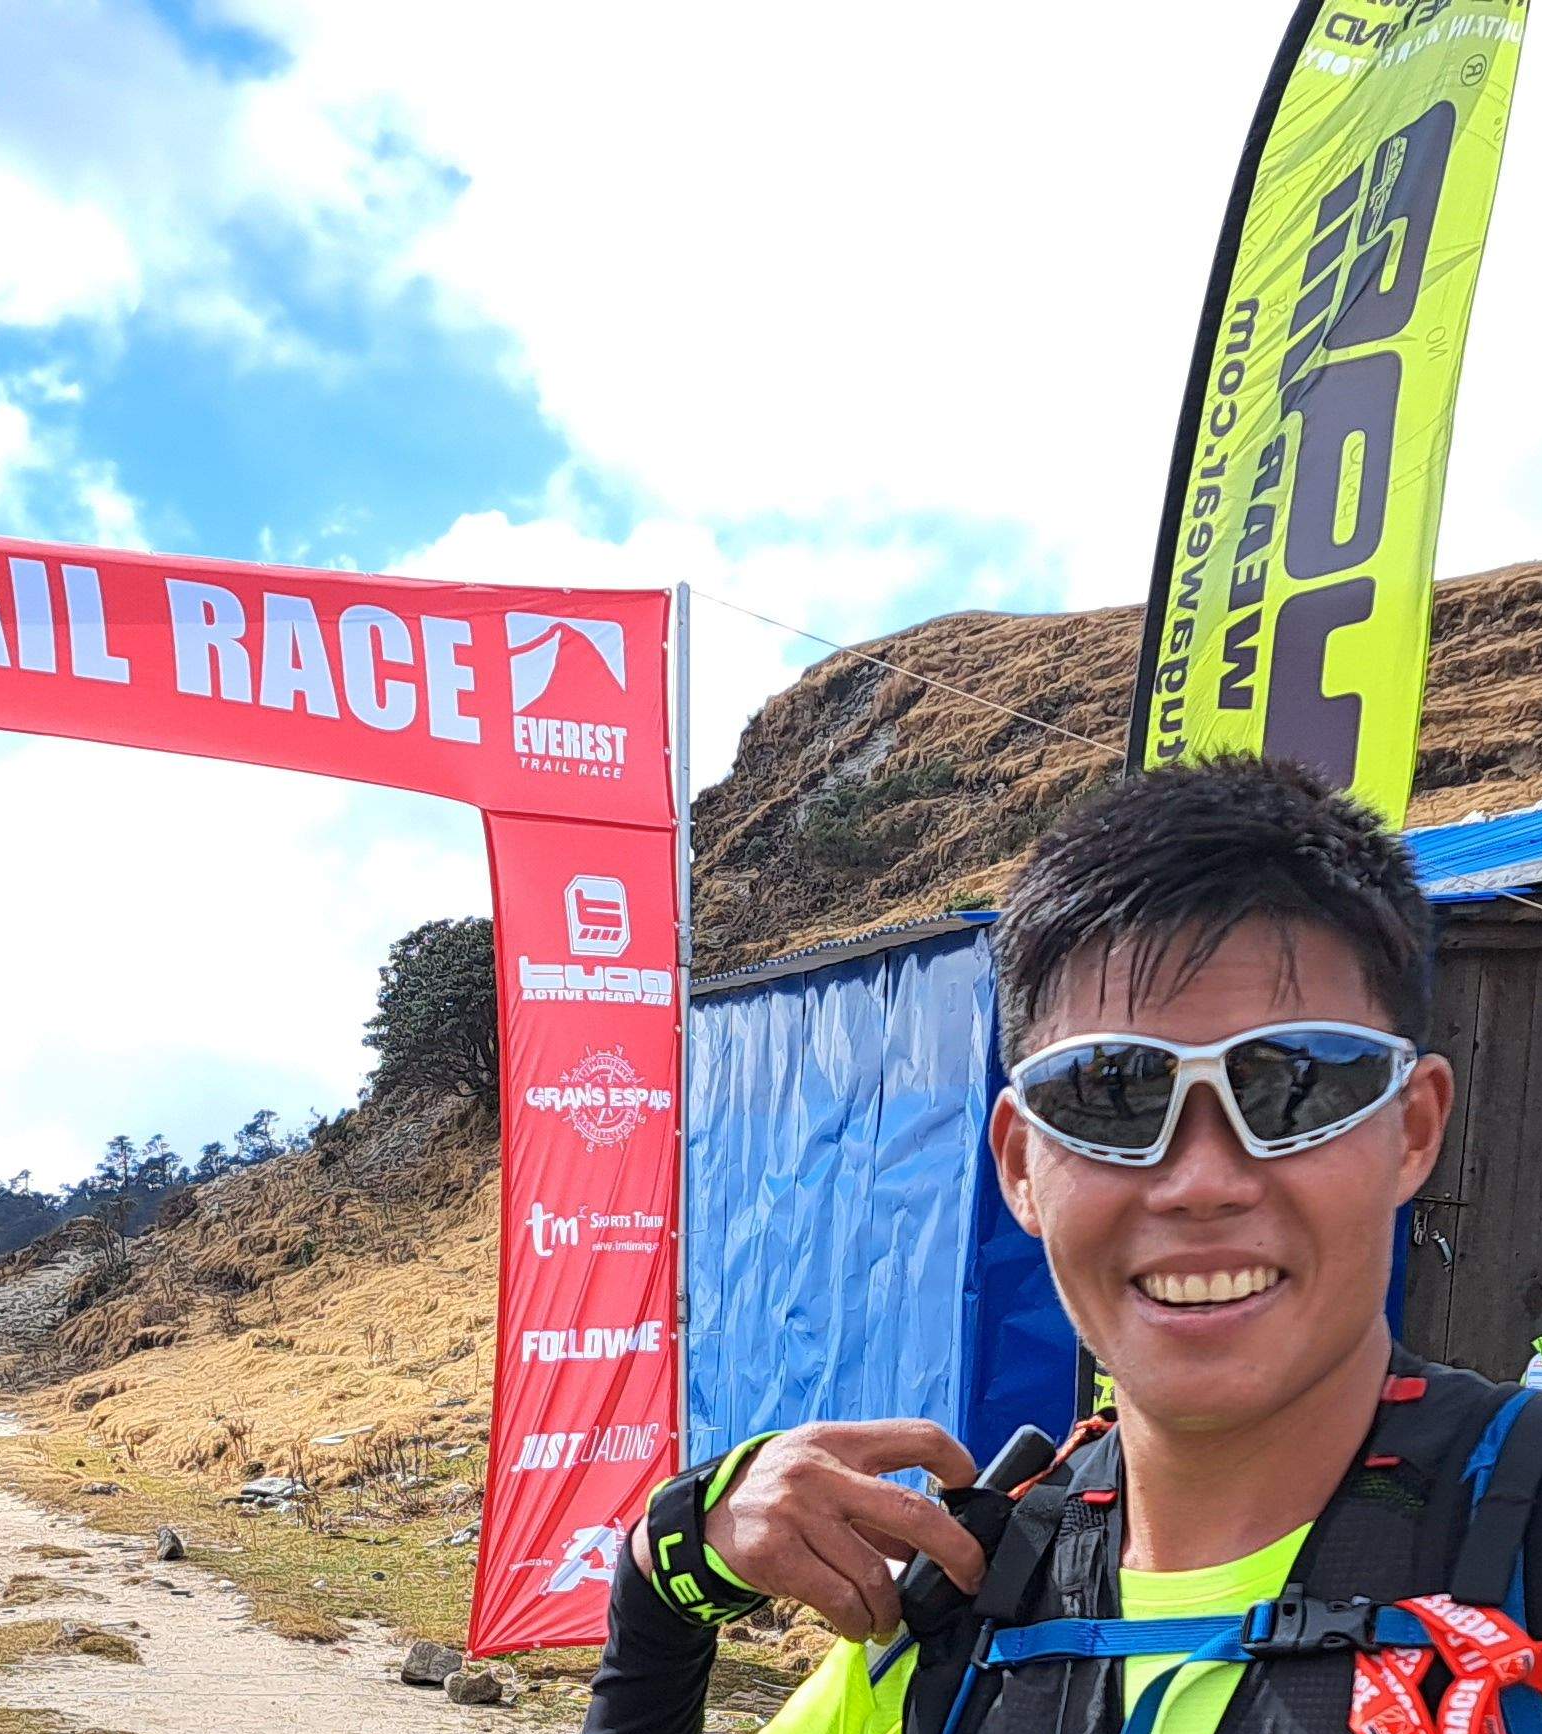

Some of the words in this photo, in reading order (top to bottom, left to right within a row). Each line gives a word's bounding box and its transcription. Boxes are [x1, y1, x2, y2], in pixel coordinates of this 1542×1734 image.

[164, 577, 481, 744] RACE
[513, 714, 628, 765] EVEREST
[519, 756, 570, 774] TRAIL
[579, 762, 623, 779] RACE
[522, 989, 584, 1001] ACTIVE
[587, 989, 635, 1004] WEAR
